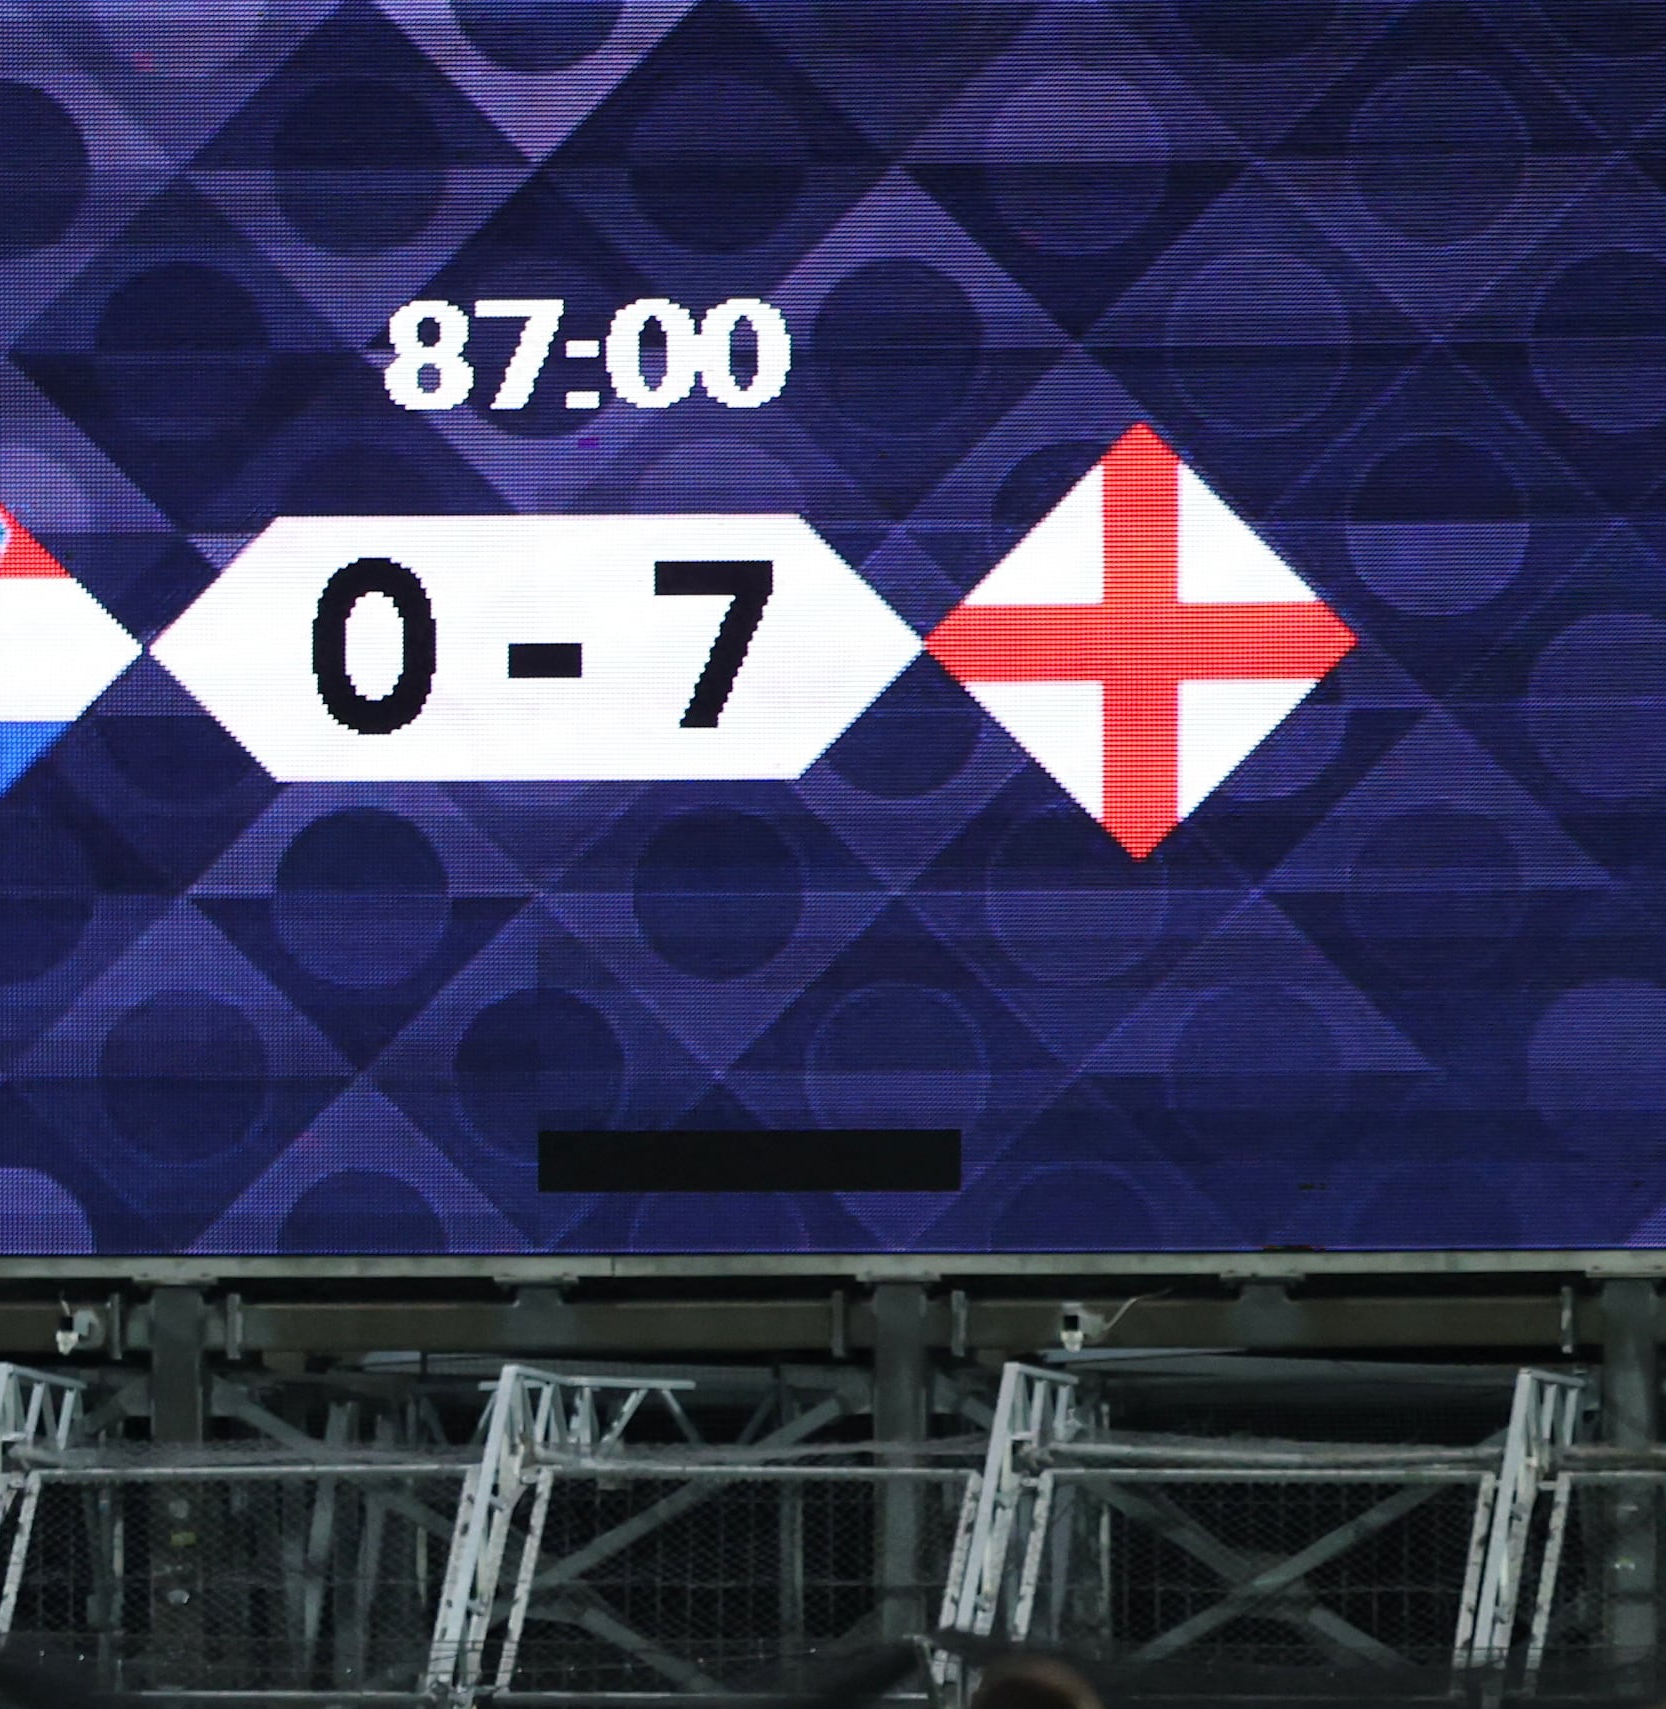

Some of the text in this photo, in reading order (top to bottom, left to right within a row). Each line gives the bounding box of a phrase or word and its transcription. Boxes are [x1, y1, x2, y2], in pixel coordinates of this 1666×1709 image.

[384, 298, 791, 411] 87:00
[311, 556, 437, 736] 0
[653, 560, 775, 729] 7
